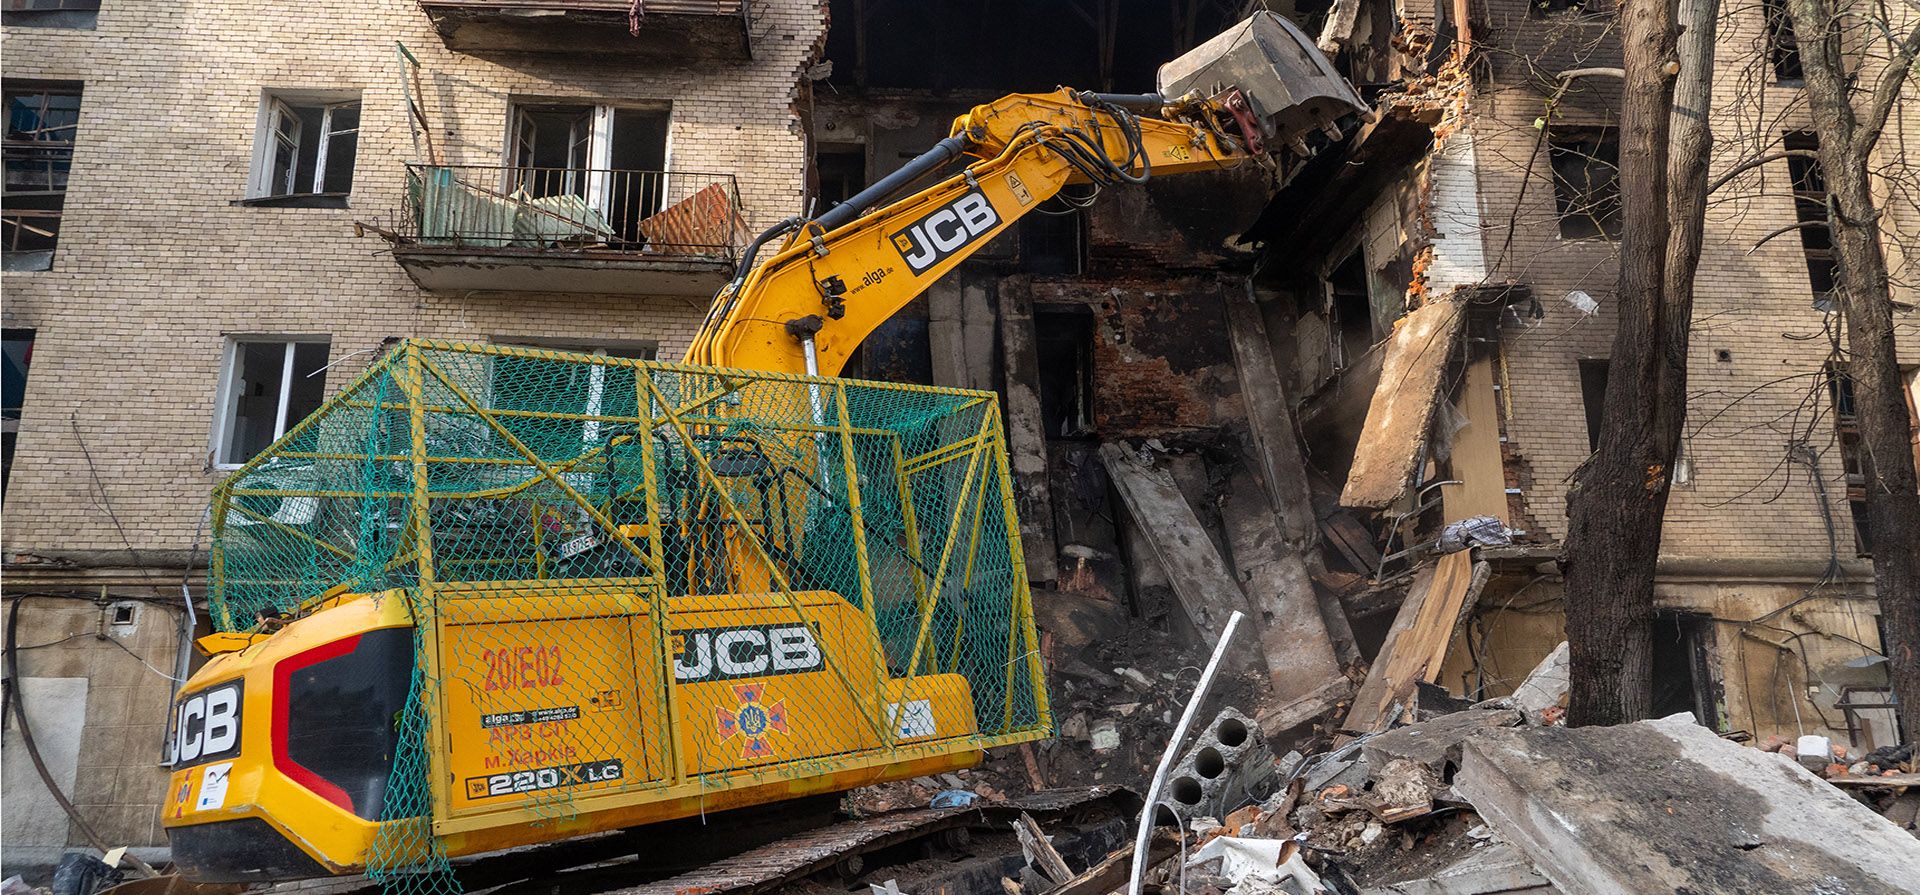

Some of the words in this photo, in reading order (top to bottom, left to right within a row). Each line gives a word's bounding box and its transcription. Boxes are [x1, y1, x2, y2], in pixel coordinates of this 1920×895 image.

[906, 192, 996, 269] JCB
[850, 267, 894, 295] www.alga.de
[673, 627, 821, 679] JCB
[171, 687, 237, 765] JCB
[485, 714, 508, 725] alga
[588, 764, 620, 781] LC
